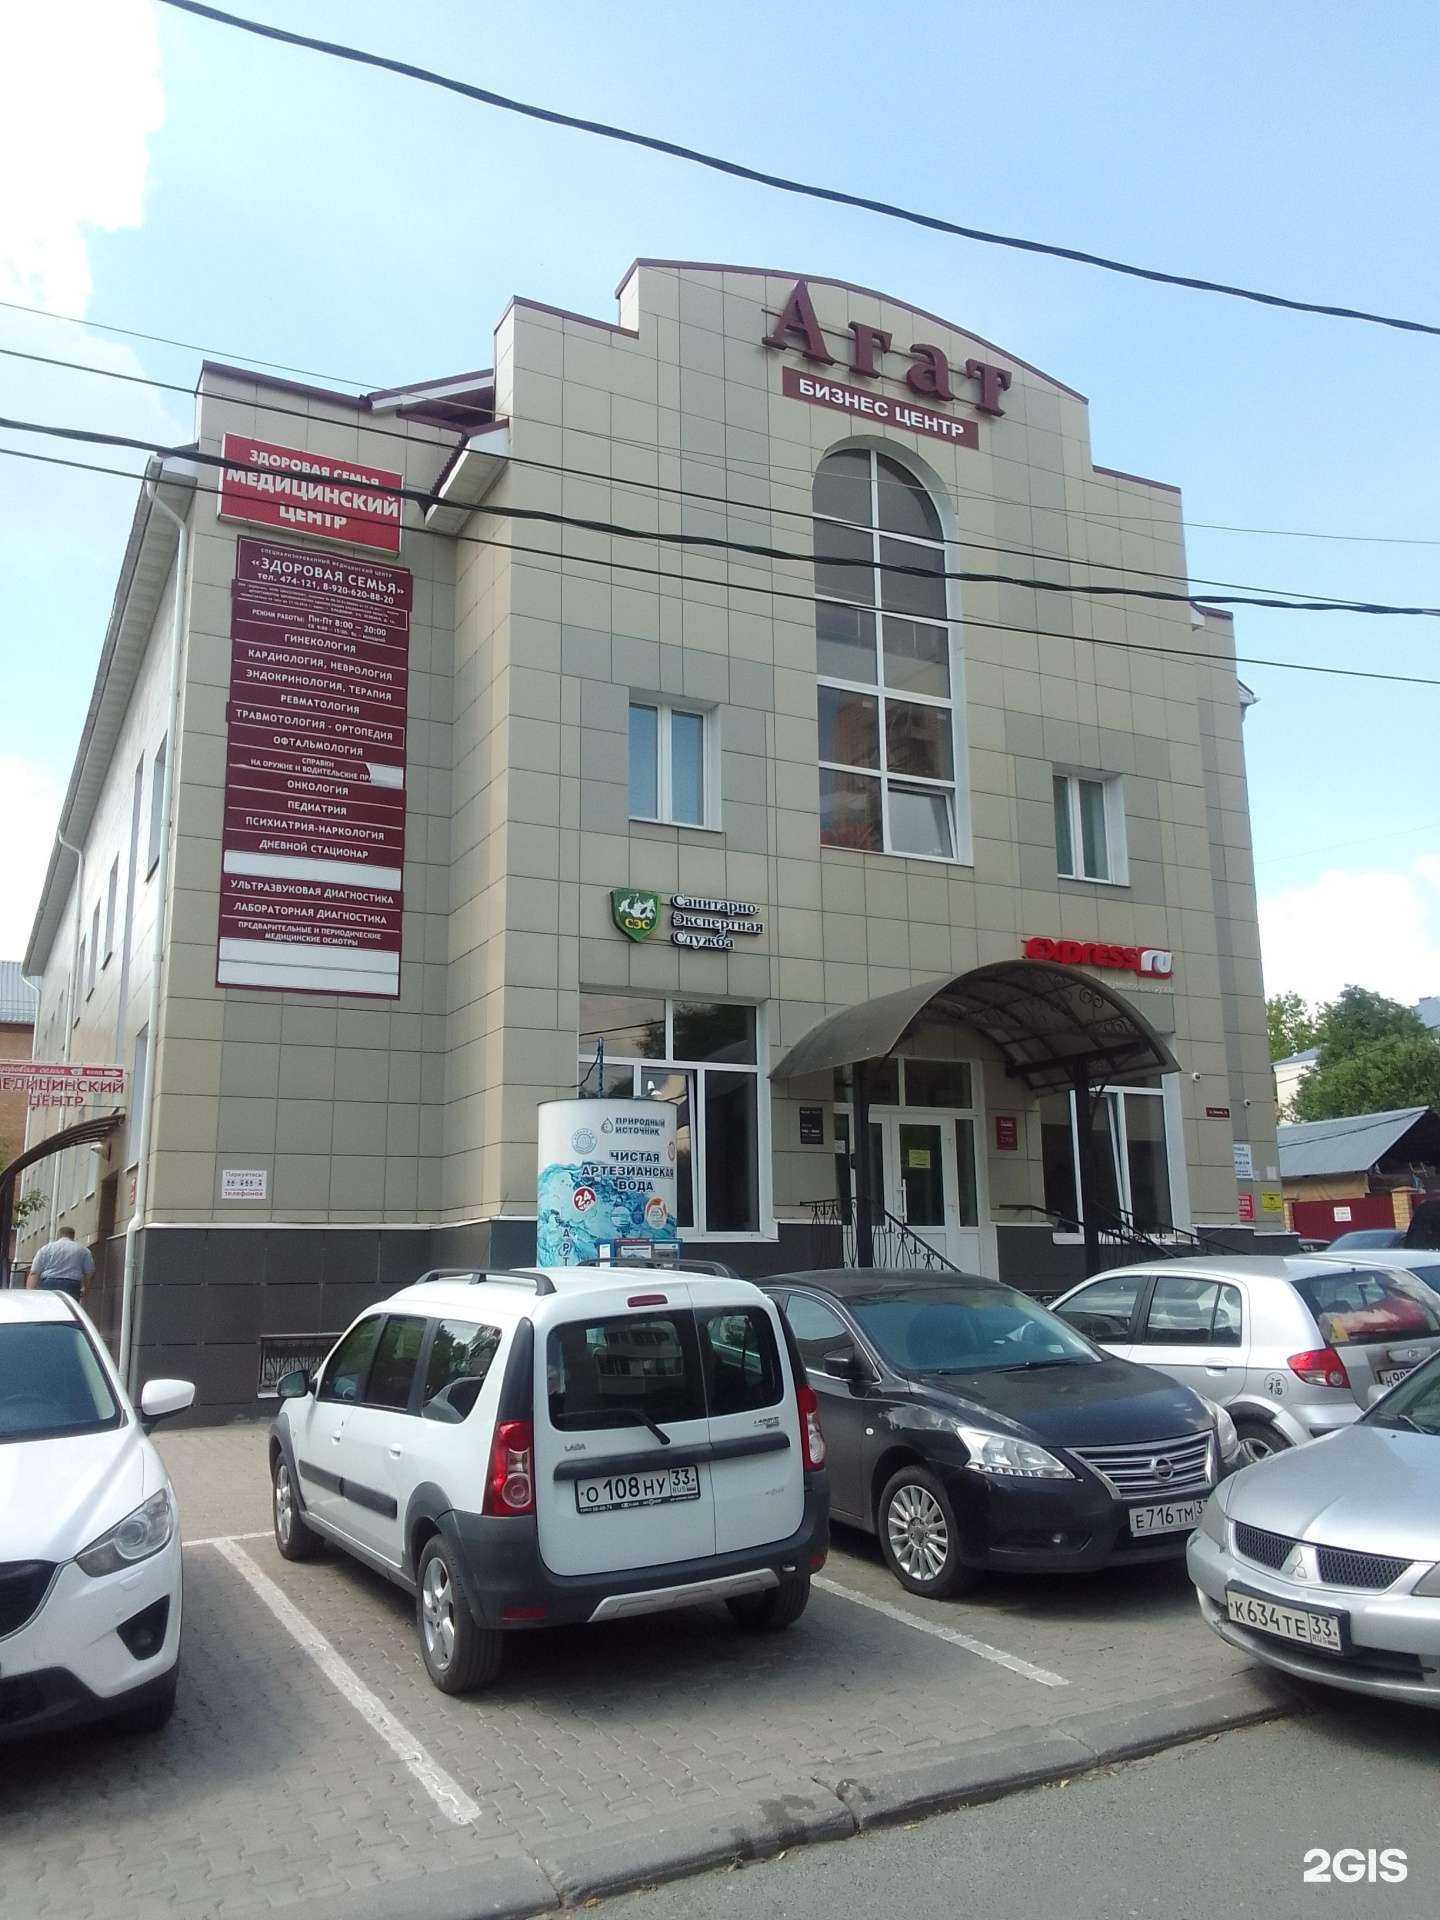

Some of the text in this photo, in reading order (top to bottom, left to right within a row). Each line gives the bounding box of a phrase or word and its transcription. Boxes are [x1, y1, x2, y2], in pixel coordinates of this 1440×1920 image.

[761, 279, 1012, 417] Агат
[799, 379, 965, 438] БИЗНЕС ЦЕНТР
[250, 450, 330, 476] ЗДОРОВАЯ
[226, 469, 399, 518] МЕДИЦИНСКИЙ
[279, 502, 348, 529] ЦЕНТР
[251, 557, 405, 595] «ЗДОРОВАЯ СЕМЬЯ»
[257, 572, 277, 582] тел.
[280, 575, 320, 591] 474-121,
[335, 619, 354, 630] 8:00
[363, 625, 387, 637] 20:00
[284, 633, 357, 654] ГИНЕКОЛОГИЯ
[248, 648, 393, 681] КАРДИОЛОГИЯ, НЕВРОЛОГИЯ
[245, 669, 392, 701] ЭНДОКРИНОЛОГИЯ, ТЕРАПИЯ
[280, 694, 360, 715] РЕВМАТОЛОГИЯ
[334, 723, 393, 741] ОРТОПЕДИЯ
[273, 735, 364, 756] ОФТАЛЬМОЛОГИЯ
[250, 758, 261, 766] НА
[302, 766, 358, 780] ВОДИТЕЛЬСКИЕ
[287, 780, 349, 795] ОНКОЛОГИЯ
[287, 800, 347, 816] ПЕДИАТРИЯ
[245, 816, 385, 841] ПСИХИАТРИЯ-НАРКОЛОГИЯ
[259, 838, 369, 859] ДНЕВНОЙ СТАЦИОНАР
[230, 879, 394, 904] УЛЬТРАЗВУКОВАЯ ДИАГНОСТИКА
[233, 902, 387, 925] ЛАБОРАТОРНАЯ ДИАГНОСТИКА
[672, 911, 764, 934] Экспертная
[237, 920, 313, 934] ПРЕДВАРИТЕЛЬНЫЕ
[321, 928, 382, 940] ПЕРИОДИЧЕСКИЕ
[264, 932, 359, 947] МЕДИЦИНСКИЕ ОСМОТРЫ
[672, 931, 734, 950] Служба
[0, 1077, 124, 1094] ЕДИЦИНСКИЙ
[29, 1094, 84, 1108] ЦЕНТР
[615, 1117, 665, 1128] ПРИРОДНЫЙ
[615, 1126, 660, 1136] ИСТОЧНИК
[610, 1151, 660, 1163] ЧИСТАЯ
[581, 1165, 673, 1177] АРТЕЗИАНСКАЯ
[618, 1180, 654, 1192] ВОДА
[671, 1468, 690, 1487] 33
[1195, 1500, 1208, 1514] 3
[1311, 1615, 1332, 1637] 33
